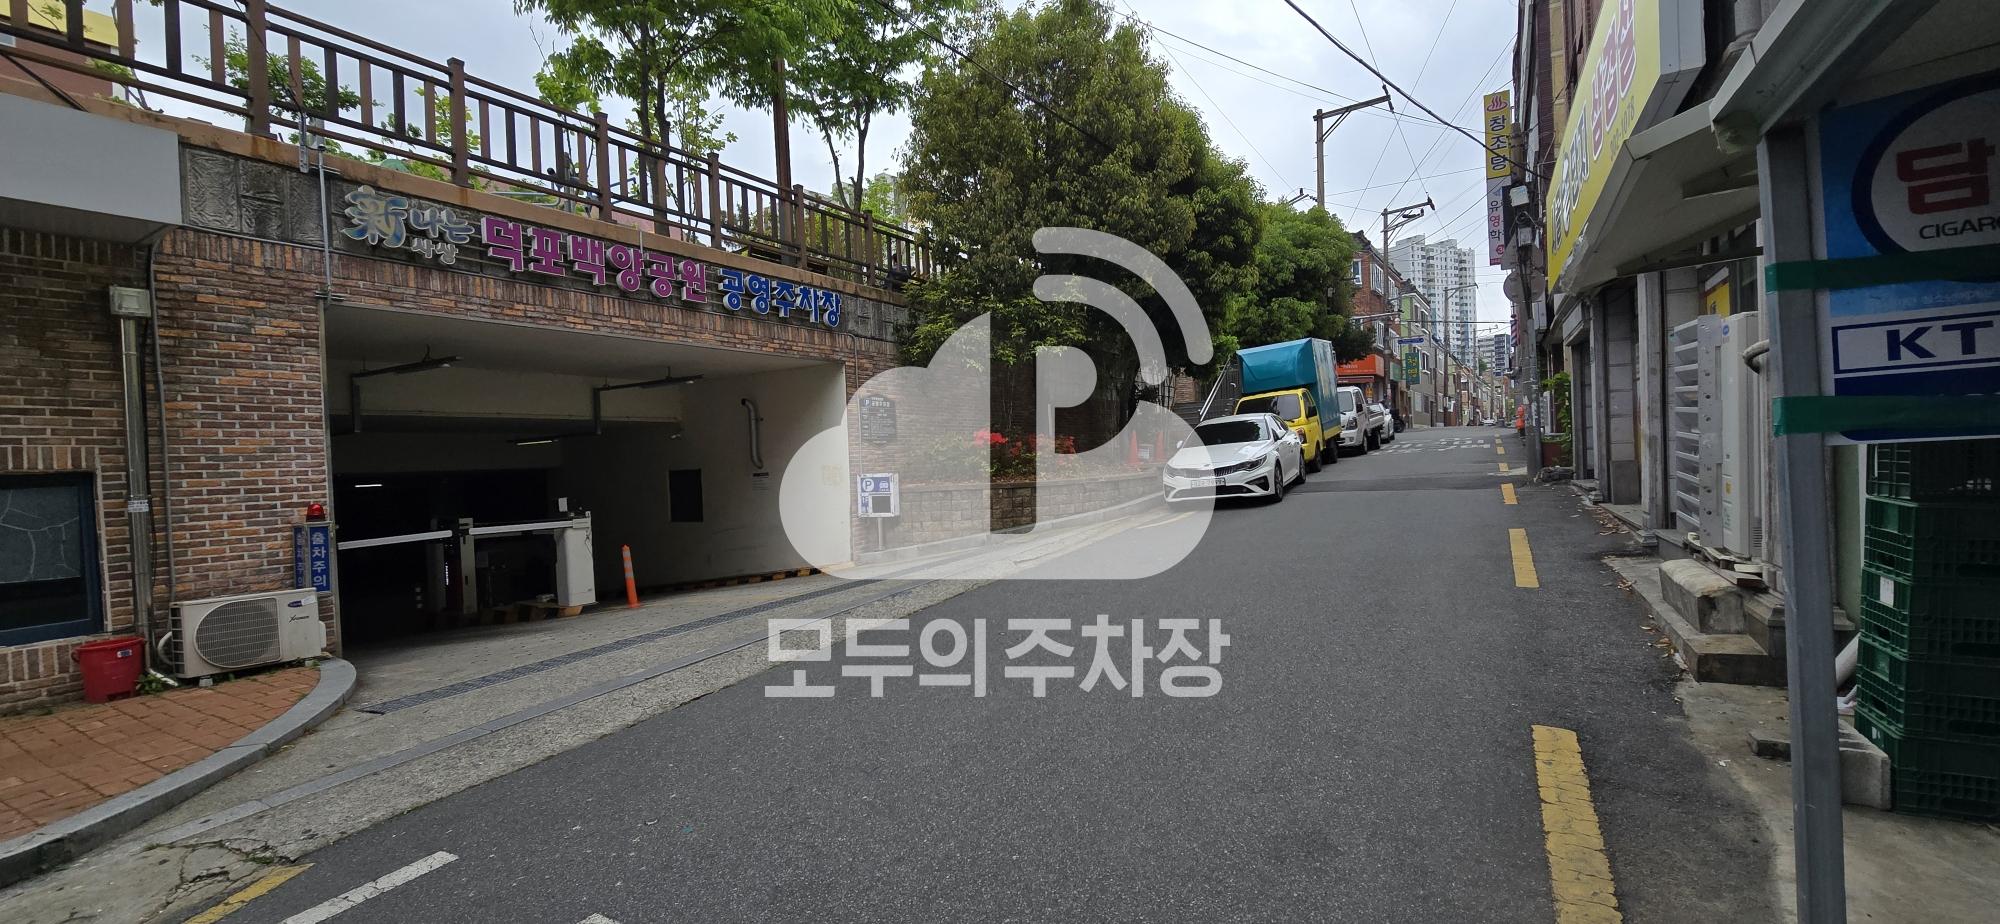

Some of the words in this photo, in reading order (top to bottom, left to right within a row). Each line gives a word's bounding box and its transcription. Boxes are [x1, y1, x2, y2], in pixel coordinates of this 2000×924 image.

[1489, 114, 1507, 171] 창조탕
[1896, 137, 1996, 215] 담
[411, 237, 459, 264] 사상
[481, 216, 707, 303] 덕포백양공원
[717, 267, 842, 328] 공영주차장
[311, 532, 327, 587] 출차주의
